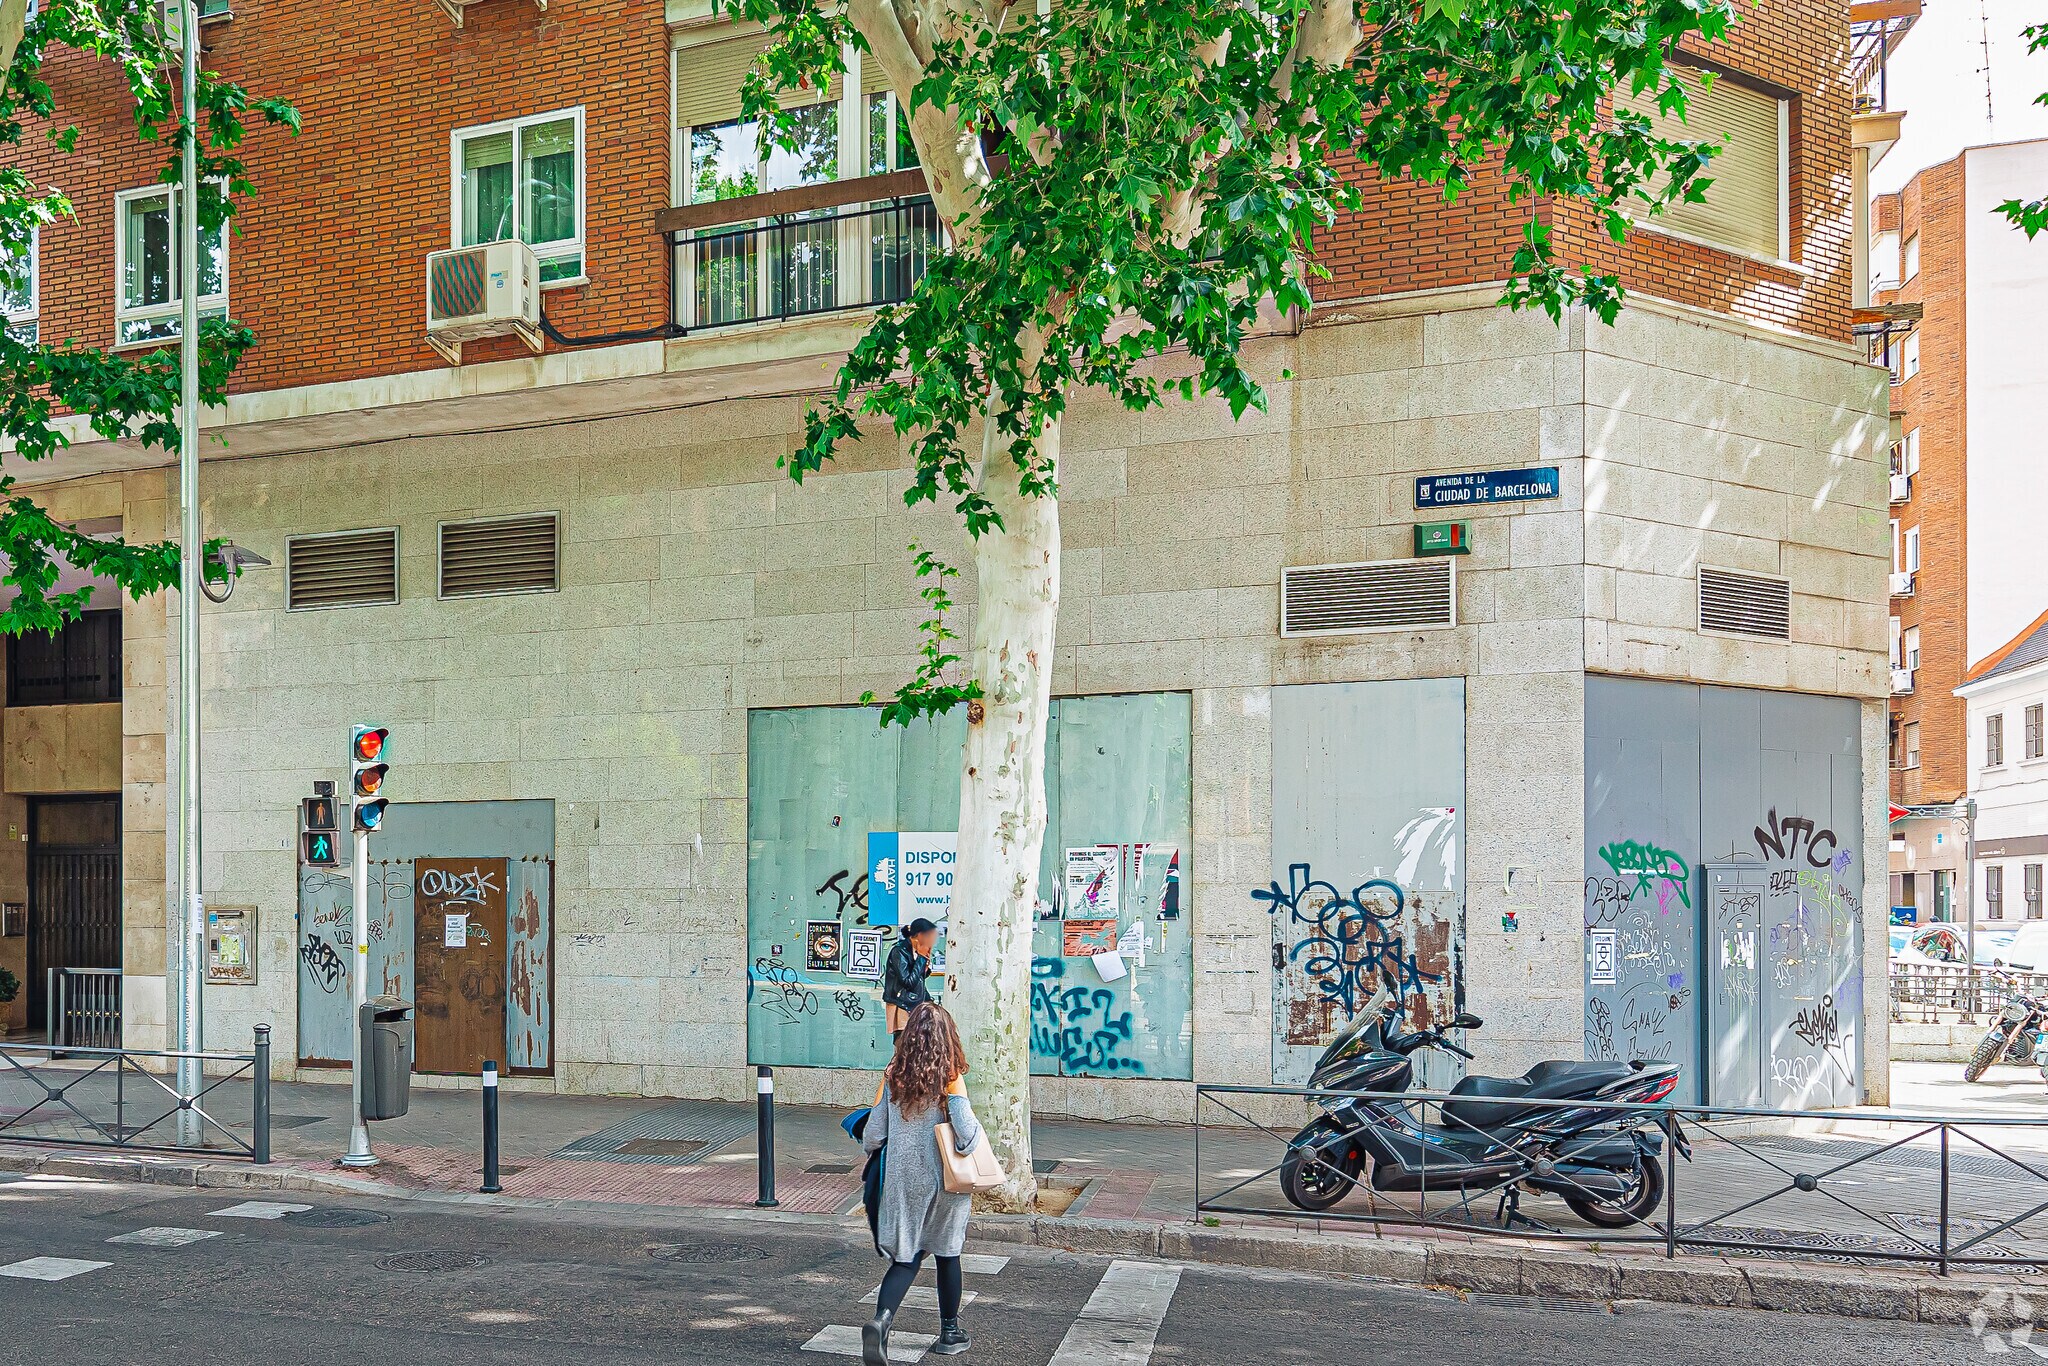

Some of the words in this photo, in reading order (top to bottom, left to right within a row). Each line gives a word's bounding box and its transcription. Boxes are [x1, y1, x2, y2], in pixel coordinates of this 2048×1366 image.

[1435, 476, 1462, 487] AVENIDA
[1465, 476, 1474, 484] DE
[1477, 475, 1486, 484] LA
[1435, 489, 1471, 502] CIUDAD
[1475, 487, 1489, 499] DE
[1495, 483, 1551, 498] BARCELONA
[1754, 805, 1837, 868] NTC
[887, 859, 896, 890] HAYA
[905, 872, 931, 886] 917
[936, 872, 953, 886] 90
